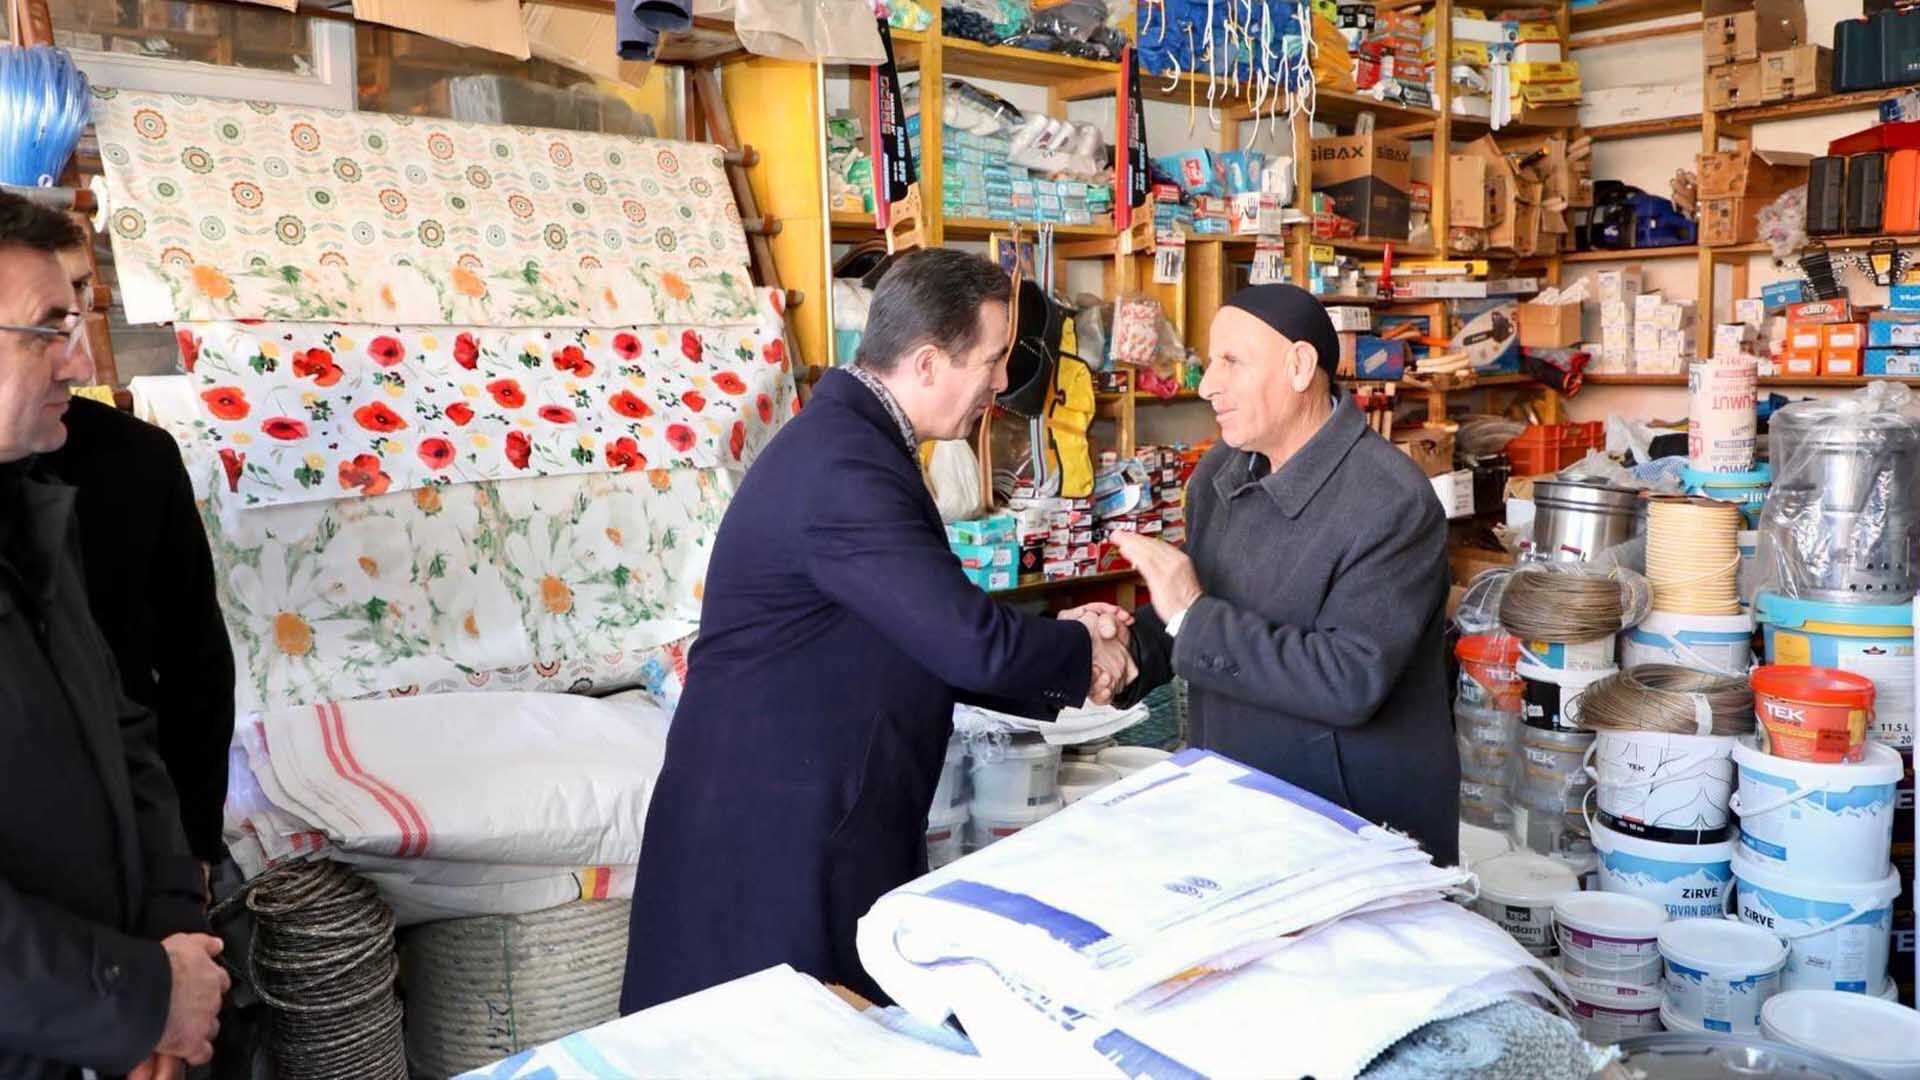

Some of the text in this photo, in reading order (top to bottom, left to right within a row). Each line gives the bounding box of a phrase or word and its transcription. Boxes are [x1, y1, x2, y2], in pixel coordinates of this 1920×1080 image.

[1763, 700, 1806, 722] TEK
[1524, 747, 1556, 766] TEK
[1627, 762, 1646, 772] TEK
